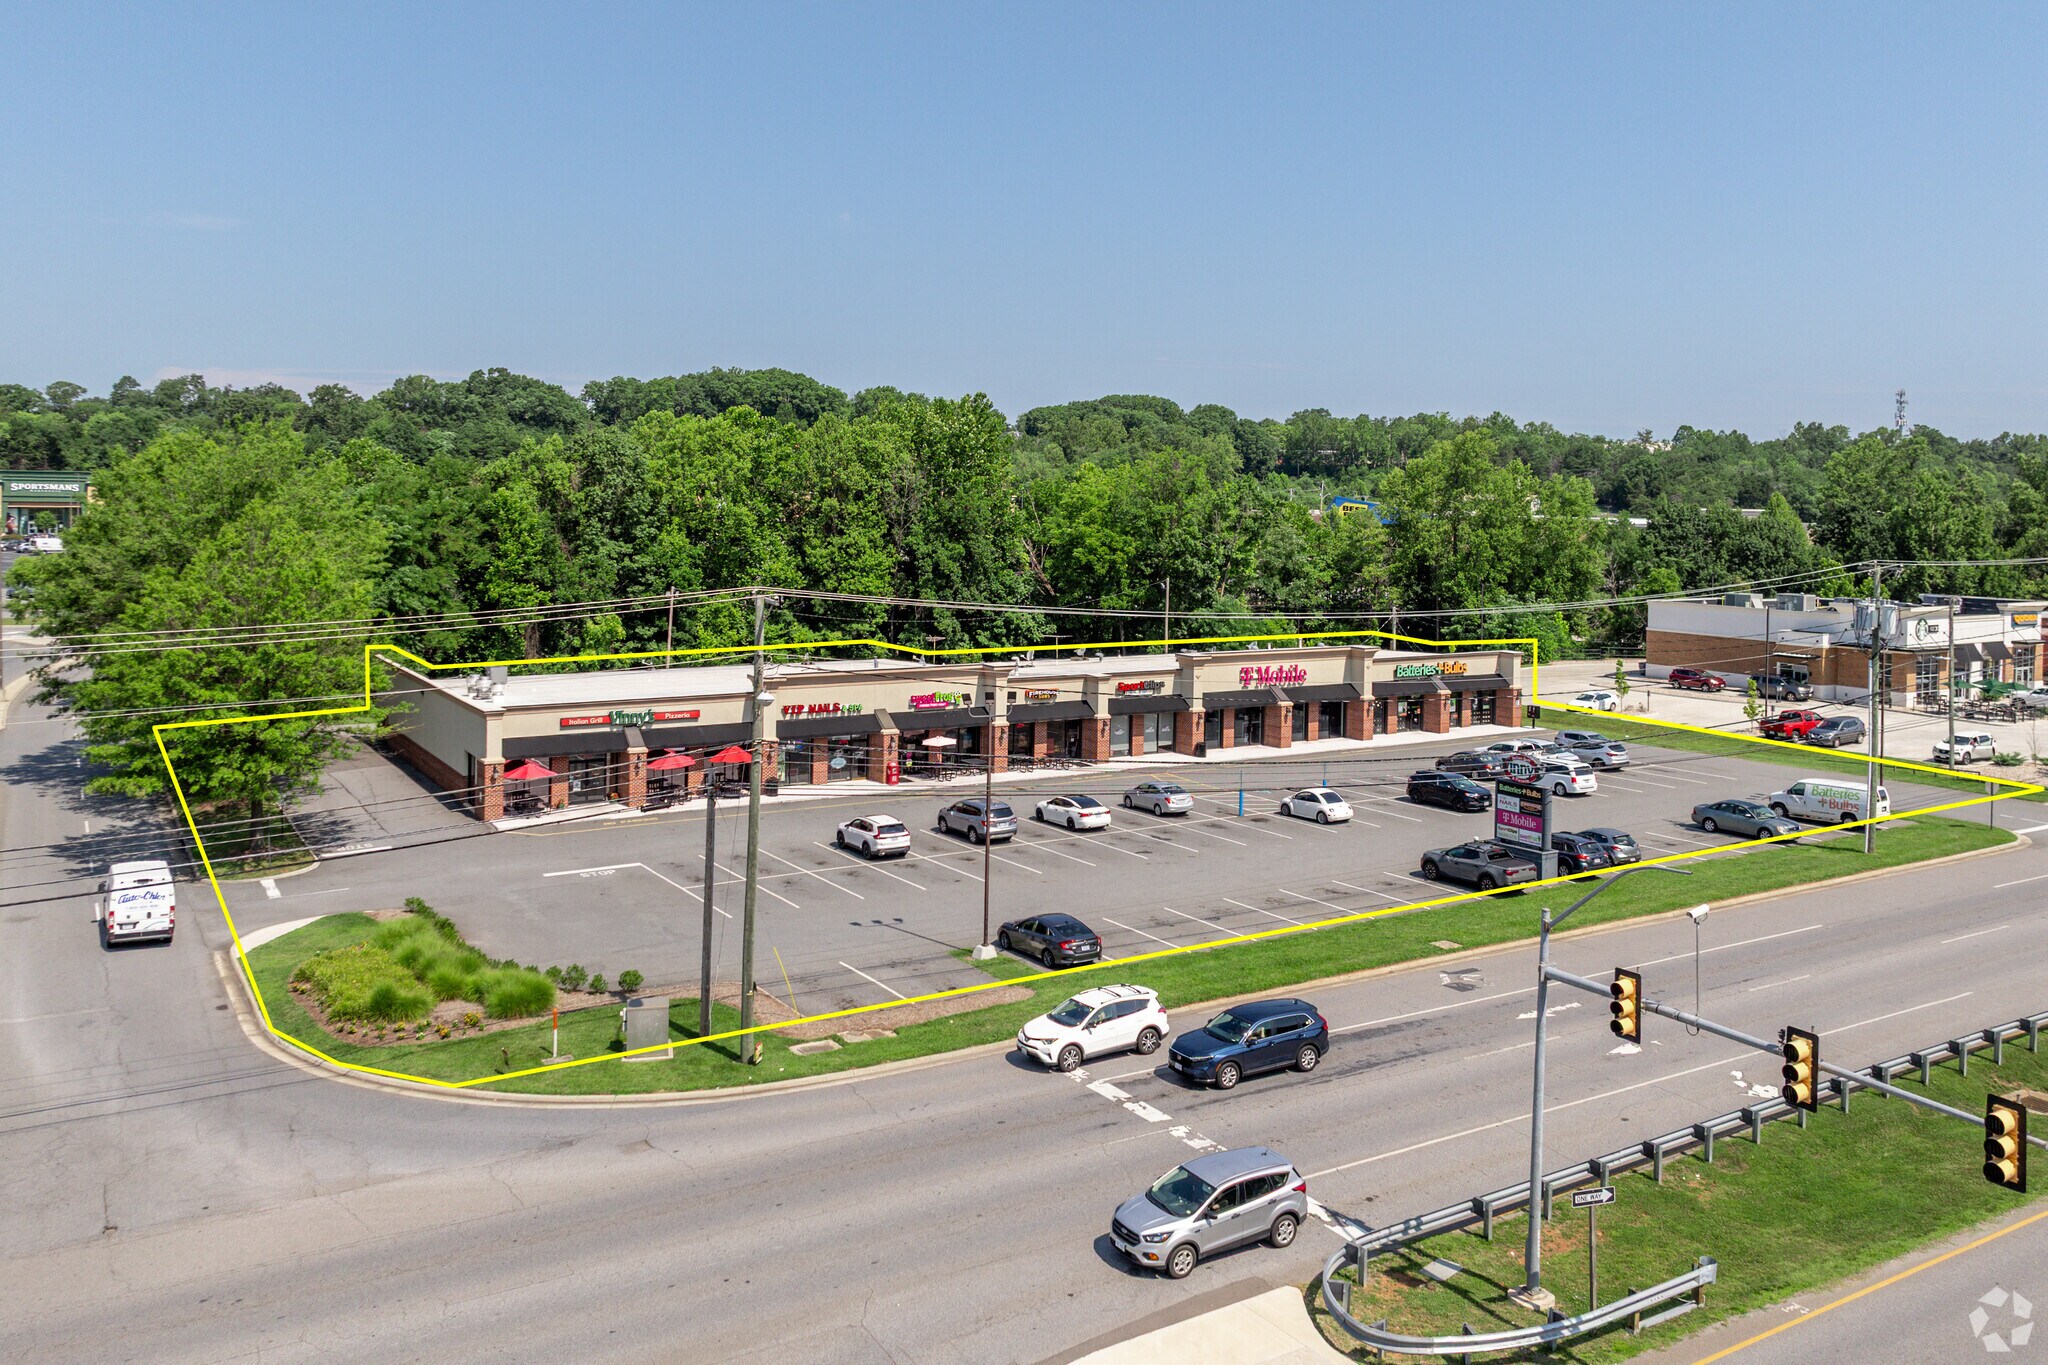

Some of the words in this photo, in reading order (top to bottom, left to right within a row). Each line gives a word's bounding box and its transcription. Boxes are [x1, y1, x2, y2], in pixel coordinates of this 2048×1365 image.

[10, 483, 80, 492] SPORTSMANS
[1396, 664, 1436, 678] Batteries
[1444, 661, 1467, 675] Bulbs
[783, 704, 805, 715] VIP
[808, 703, 841, 714] NAILS
[568, 718, 589, 726] Italian
[609, 709, 655, 727] Vinny's
[1499, 784, 1522, 794] Batteries
[1526, 788, 1541, 799] Bulbs
[1811, 785, 1860, 800] Batteries
[1500, 799, 1518, 808] NAILS
[1829, 798, 1860, 813] Bulbs
